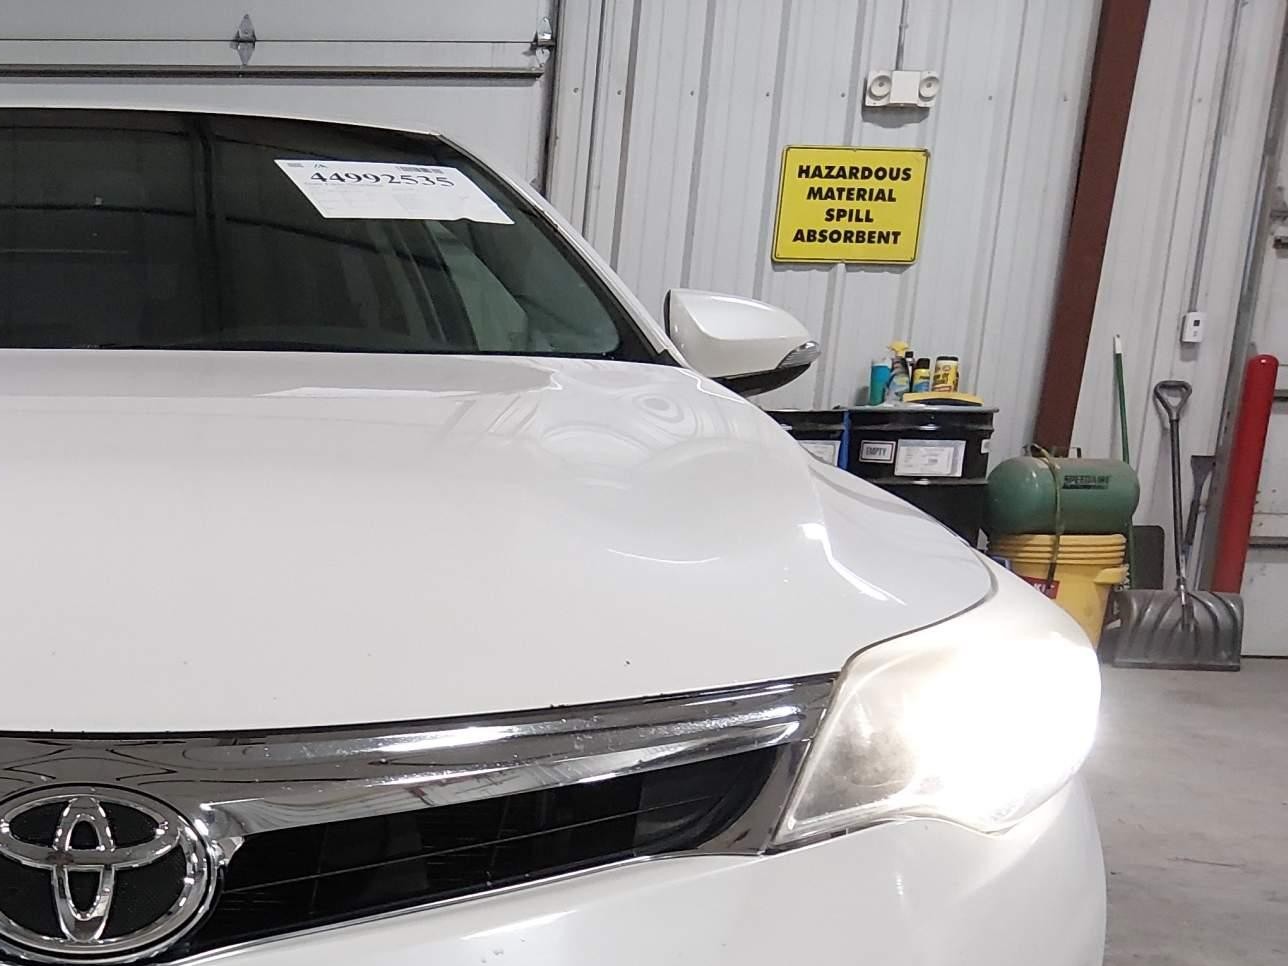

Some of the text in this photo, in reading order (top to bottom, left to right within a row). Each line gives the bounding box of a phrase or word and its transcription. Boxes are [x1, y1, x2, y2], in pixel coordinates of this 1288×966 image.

[310, 172, 456, 187] 44992535
[797, 165, 912, 182] HAZARDOUS
[806, 187, 897, 203] MATERIAL
[824, 208, 874, 223] SPILL
[792, 229, 902, 245] ABSORBENT
[865, 447, 887, 457] EMPTY
